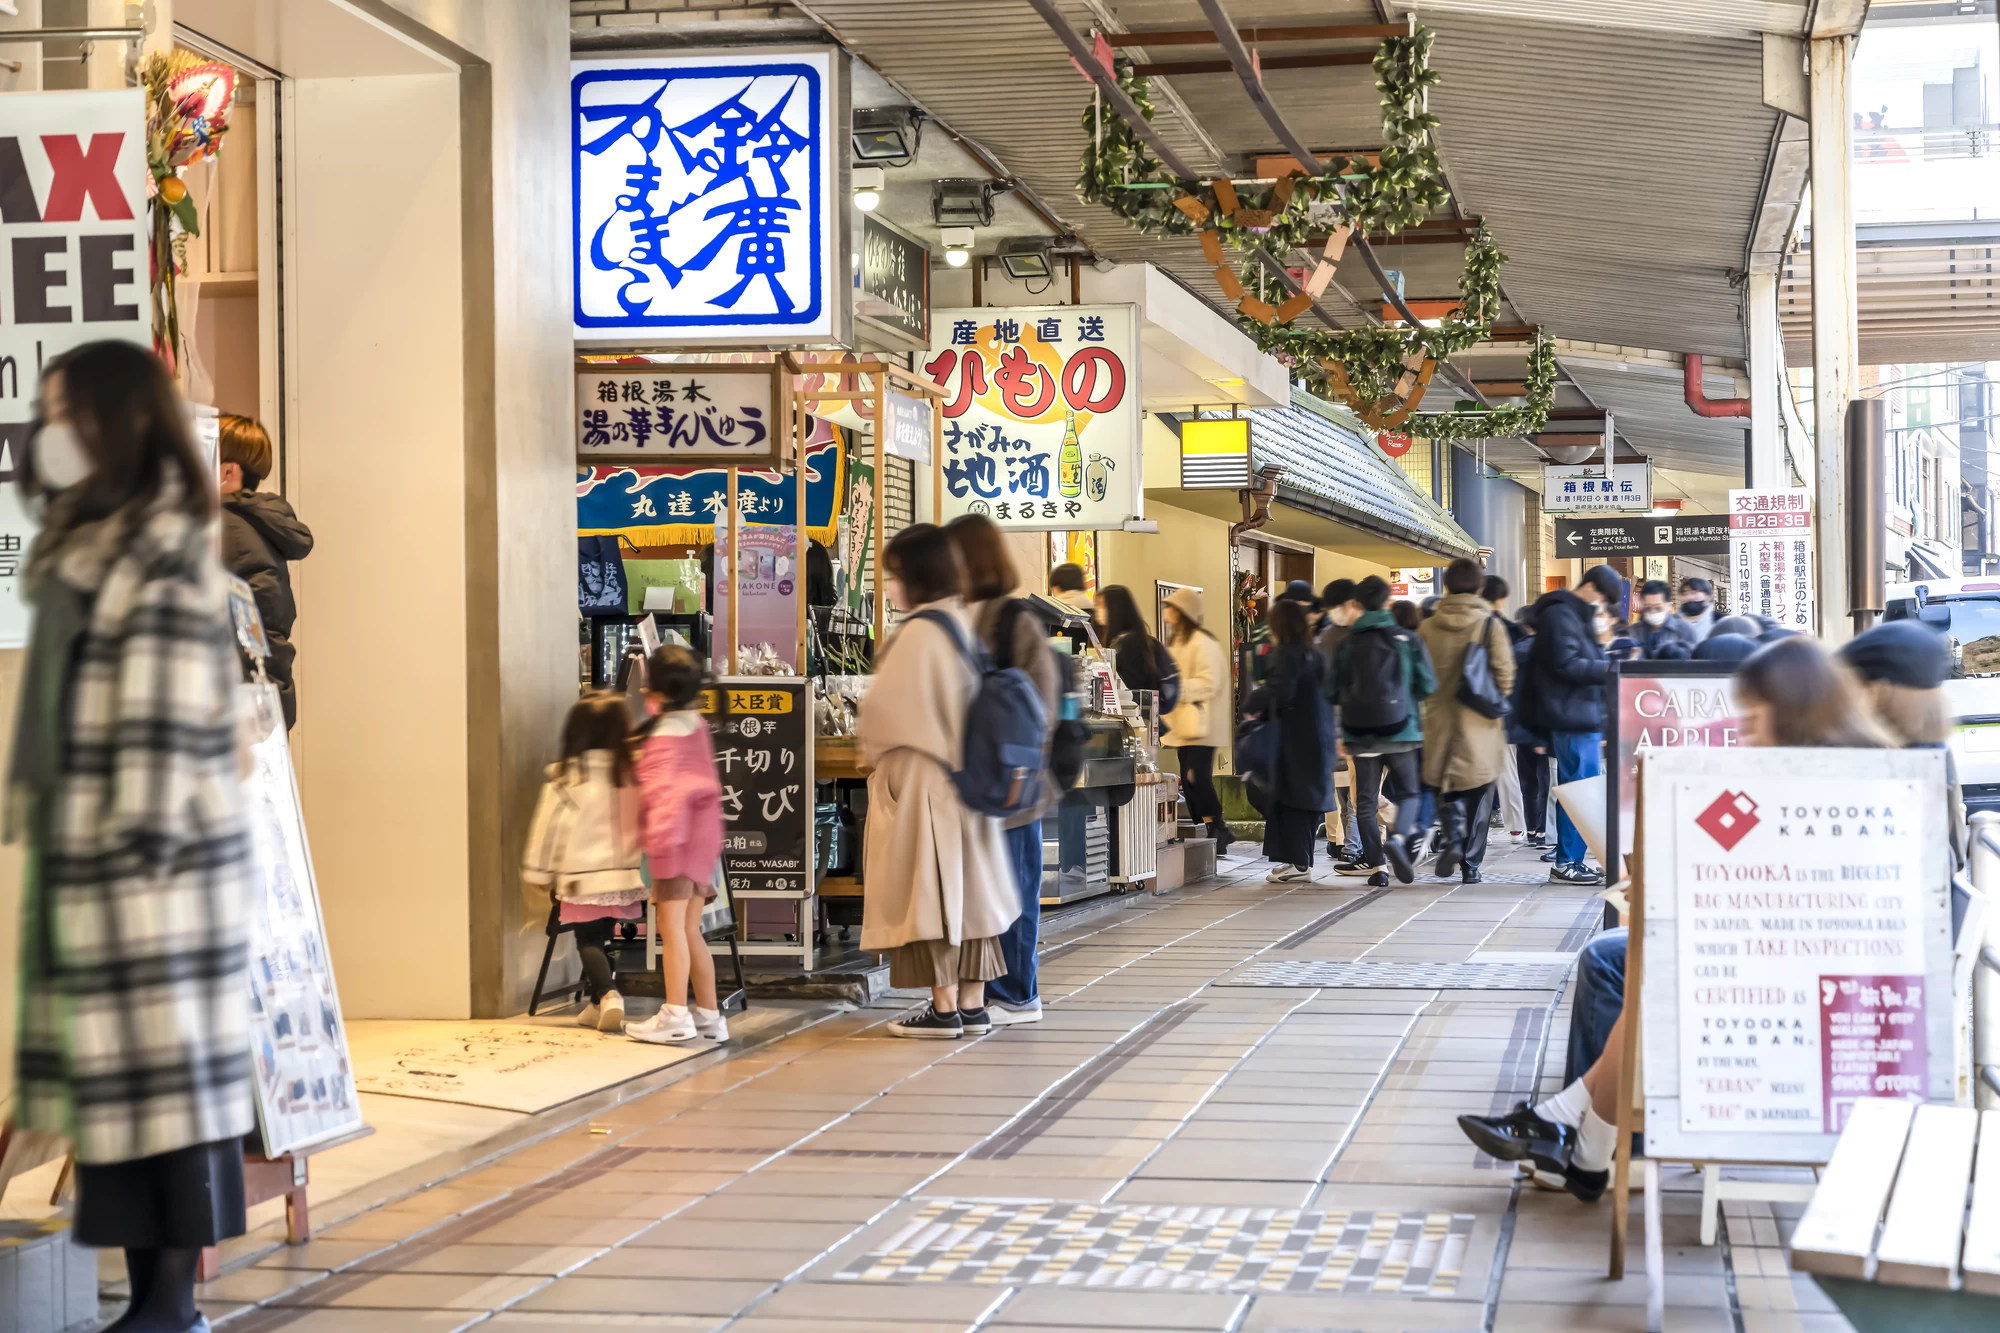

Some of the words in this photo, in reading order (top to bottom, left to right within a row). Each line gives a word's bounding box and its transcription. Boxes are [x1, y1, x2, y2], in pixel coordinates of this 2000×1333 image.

[951, 316, 1105, 345] 産地直送
[925, 345, 1126, 418] ひもの
[597, 379, 712, 405] 箱根湯本
[943, 420, 1031, 453] さがみの
[943, 452, 1050, 499] 地酒
[1563, 480, 1633, 493] 箱根駅伝
[1620, 494, 1641, 502] 1月3日
[1735, 494, 1804, 511] 交通規制
[995, 500, 1082, 520] まるきや
[1590, 536, 1636, 545] 上ってください
[1773, 541, 1786, 624] 箱根湯本駅〜フィ
[1793, 540, 1807, 624] 箱根駅伝のため
[1780, 806, 1894, 819] TOYOOKA
[1779, 825, 1895, 836] KABAN
[730, 860, 757, 868] Foods
[1693, 863, 1792, 881] TOYOOKA
[1811, 868, 1835, 882] THE
[1727, 893, 1868, 909] MANUFACTURING
[1695, 943, 1738, 956] WHICH
[1744, 939, 1788, 956] TAKE
[1793, 938, 1905, 956] INSPECTIONS
[1694, 987, 1786, 1006] CERTIFIED
[1703, 1018, 1803, 1030] TOYOOKA
